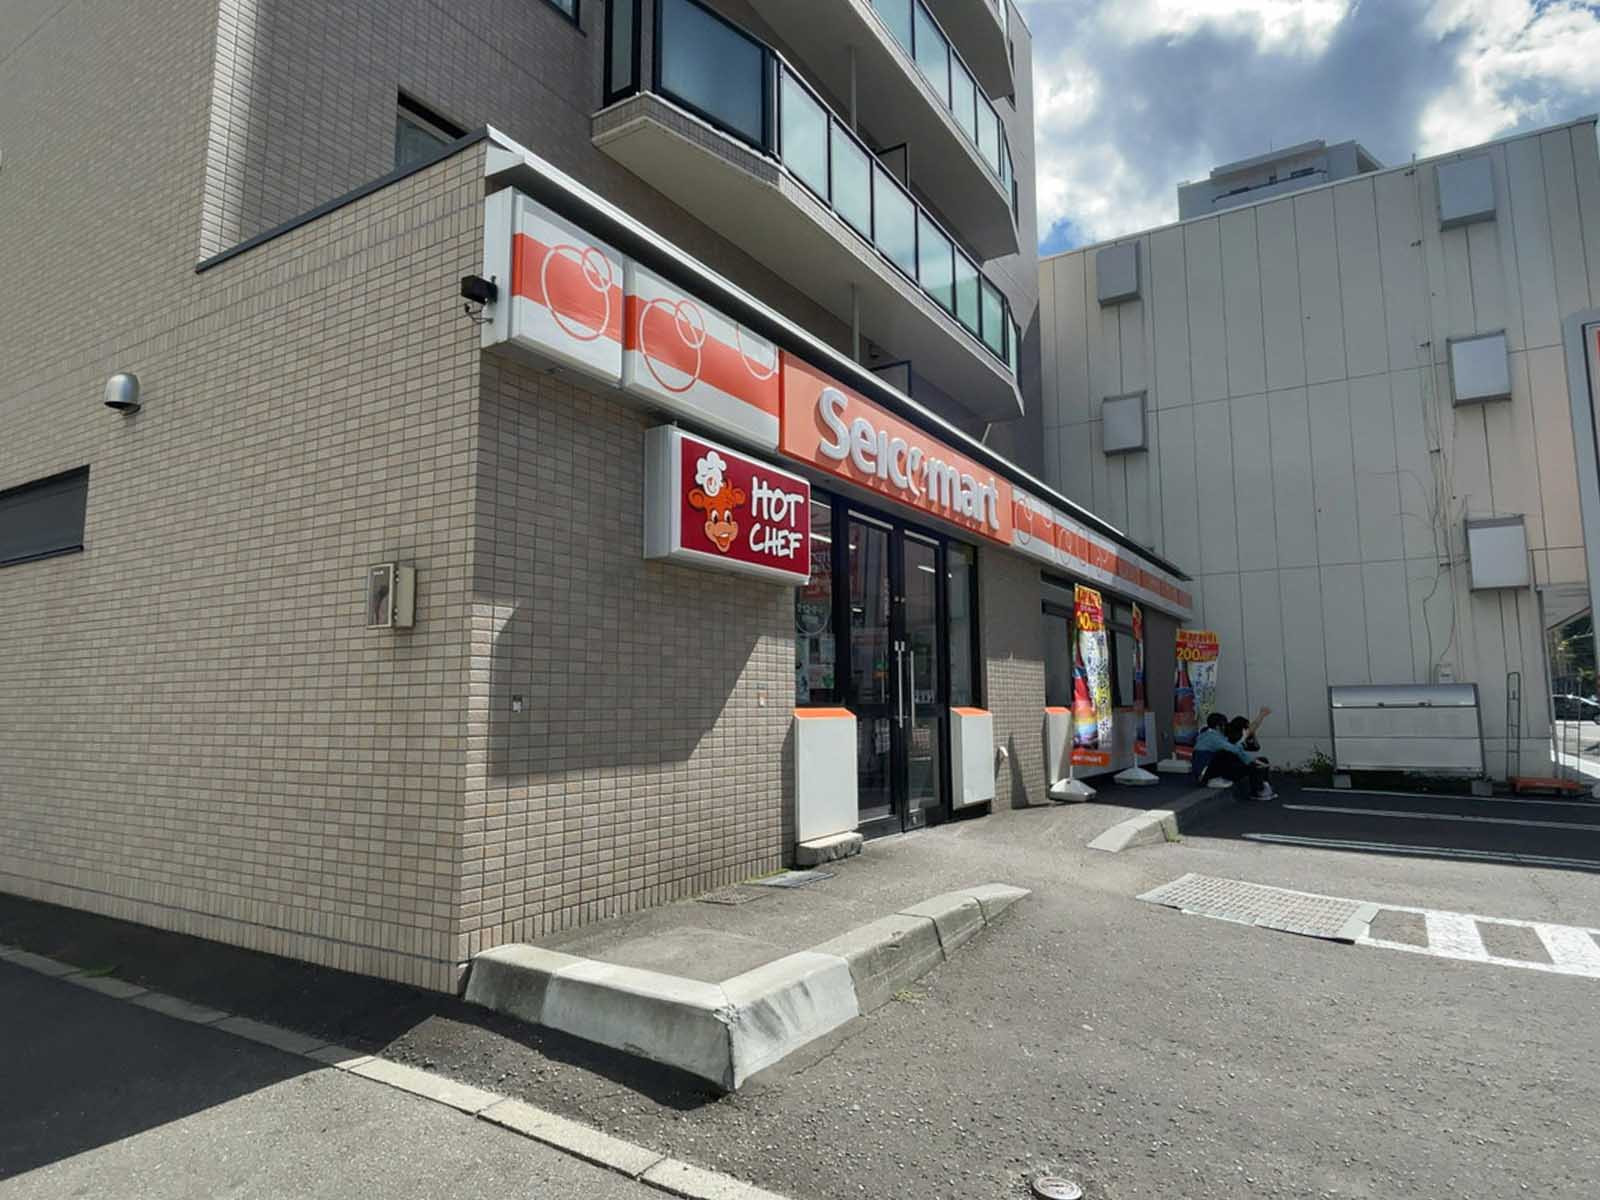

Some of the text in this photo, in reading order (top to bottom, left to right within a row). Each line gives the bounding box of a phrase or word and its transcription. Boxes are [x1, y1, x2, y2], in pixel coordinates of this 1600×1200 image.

[819, 387, 999, 530] Seicomart
[752, 476, 804, 527] HOT
[750, 524, 802, 559] CHEF
